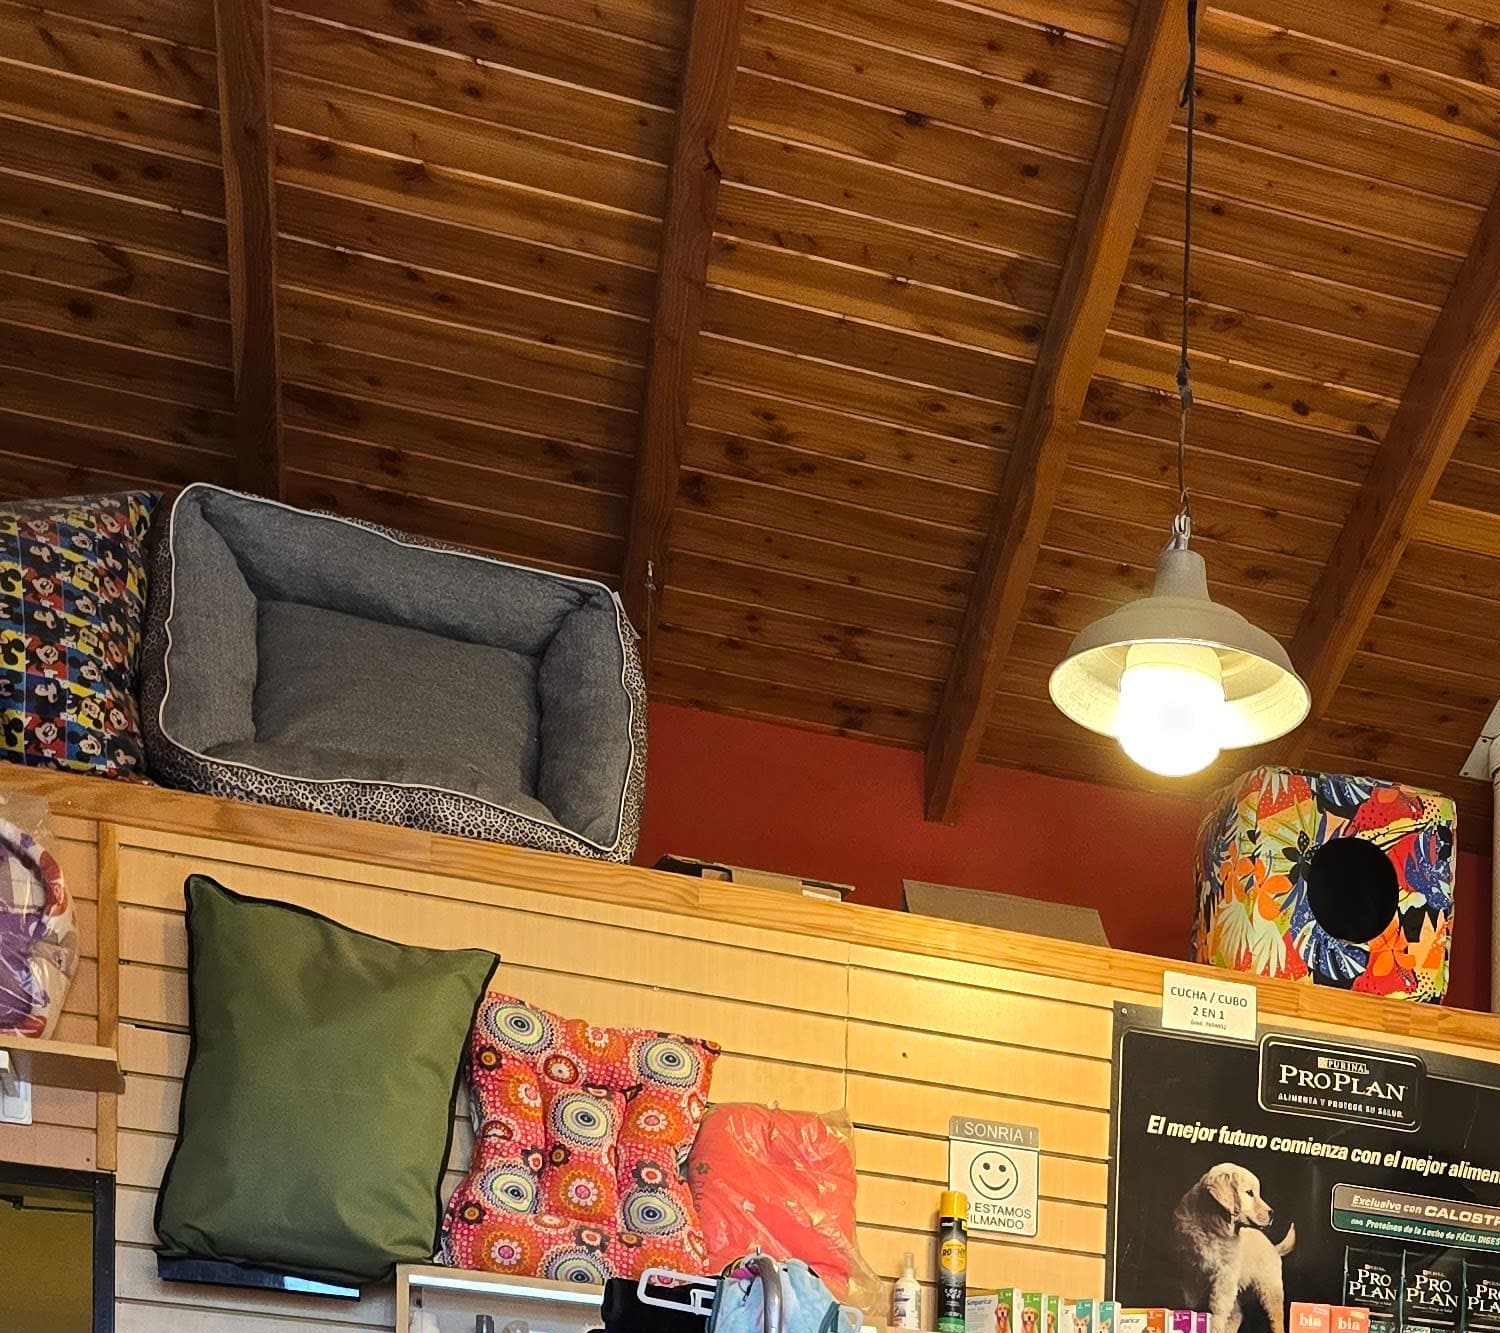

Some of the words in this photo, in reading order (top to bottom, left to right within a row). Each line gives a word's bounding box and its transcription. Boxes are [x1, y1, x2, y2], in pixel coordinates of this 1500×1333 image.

[1170, 986, 1207, 1002] CUCHA
[1218, 993, 1248, 1008] CUBO
[1193, 1006, 1199, 1016] 2
[1202, 1009, 1216, 1019] EN
[1219, 1010, 1225, 1020] 1
[963, 1120, 1025, 1143] SONRIA
[1146, 1114, 1166, 1135] El
[1166, 1118, 1219, 1144] mejor
[1218, 1125, 1268, 1150] futuro
[1270, 1137, 1348, 1161] comienza
[1350, 1148, 1382, 1166] con
[1384, 1150, 1402, 1169] el
[1401, 1155, 1448, 1177] mejor
[974, 1202, 1032, 1219] ESTAMOS
[1352, 1195, 1402, 1212] Exclusivo
[1403, 1203, 1422, 1215] con
[967, 1214, 1025, 1230] ILMANDO
[1456, 1231, 1478, 1244] FÁCIL
[1357, 1268, 1392, 1287] PRO
[1415, 1274, 1452, 1293] PRO
[1349, 1281, 1398, 1301] PLAN
[1406, 1287, 1459, 1308] PLAN
[1299, 1313, 1322, 1327] bia
[1337, 1317, 1361, 1331] bia
